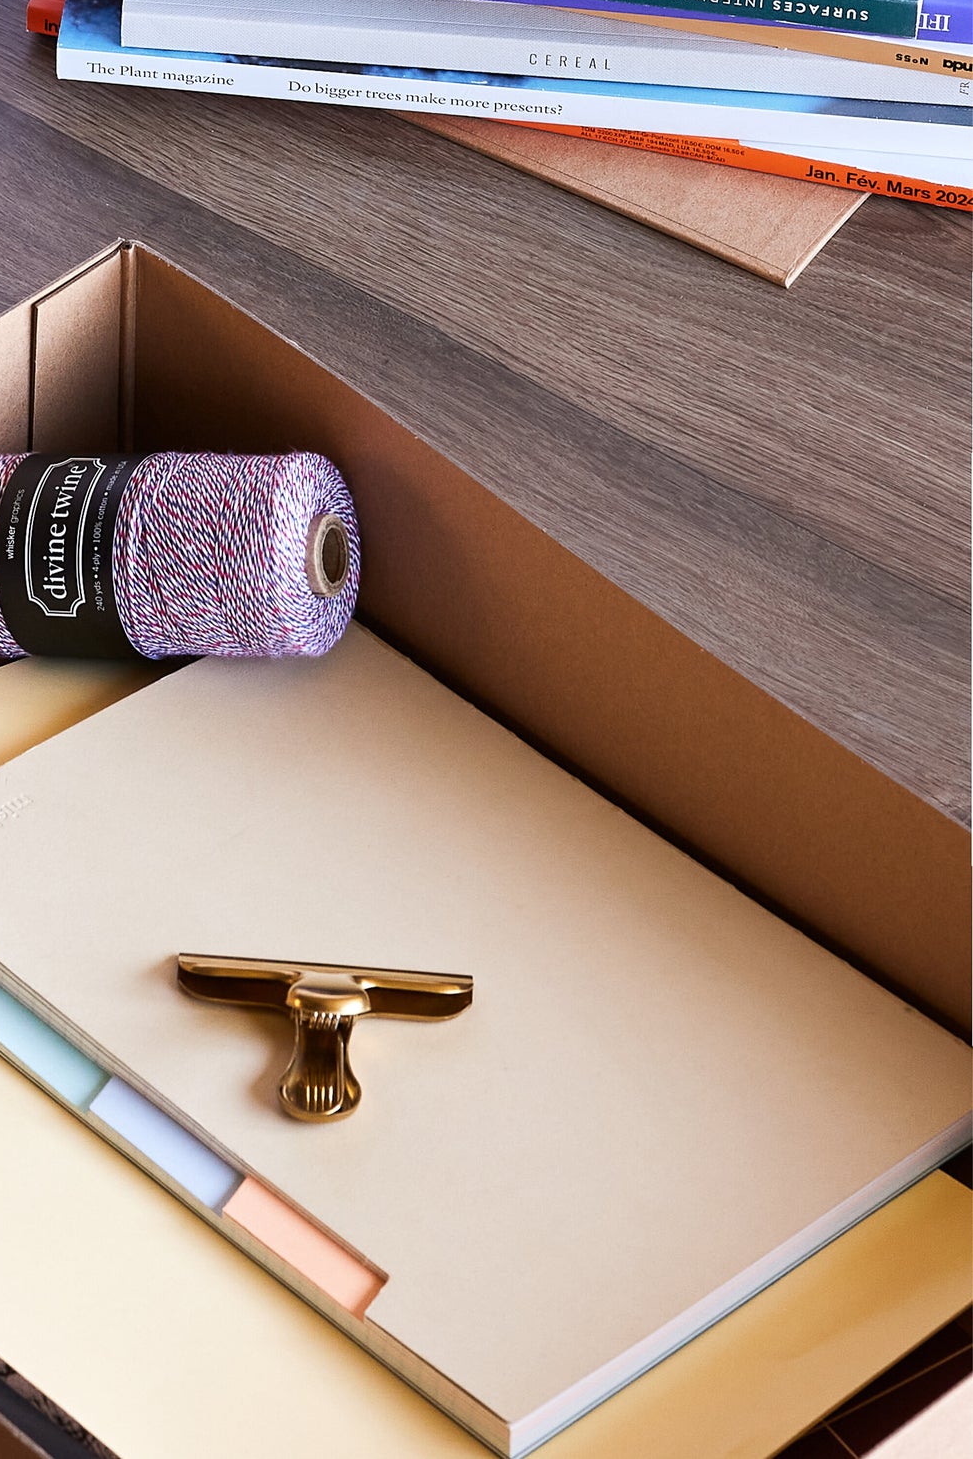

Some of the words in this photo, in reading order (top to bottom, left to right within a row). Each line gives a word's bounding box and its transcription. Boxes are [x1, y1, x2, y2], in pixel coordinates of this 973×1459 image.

[773, 0, 869, 22] SURFACES
[529, 52, 611, 71] CEREAL
[896, 53, 928, 65] N°55
[87, 62, 115, 75] The
[120, 65, 159, 81] Plant
[163, 70, 234, 87] magazine
[288, 80, 311, 93] Do
[315, 81, 362, 101] bigger
[366, 88, 401, 102] trees
[405, 91, 447, 106] make
[450, 97, 490, 110] more
[494, 101, 564, 116] presents?
[806, 165, 839, 182] Jan.
[847, 172, 880, 189] Fév.
[887, 180, 931, 199] Mars
[51, 465, 87, 518] twine
[10, 488, 26, 524] graphics
[98, 497, 108, 520] cotton
[6, 525, 15, 560] whisker
[93, 521, 103, 543] 100%
[43, 523, 67, 599] divine
[92, 552, 101, 572] 4-ply
[93, 596, 105, 611] 240
